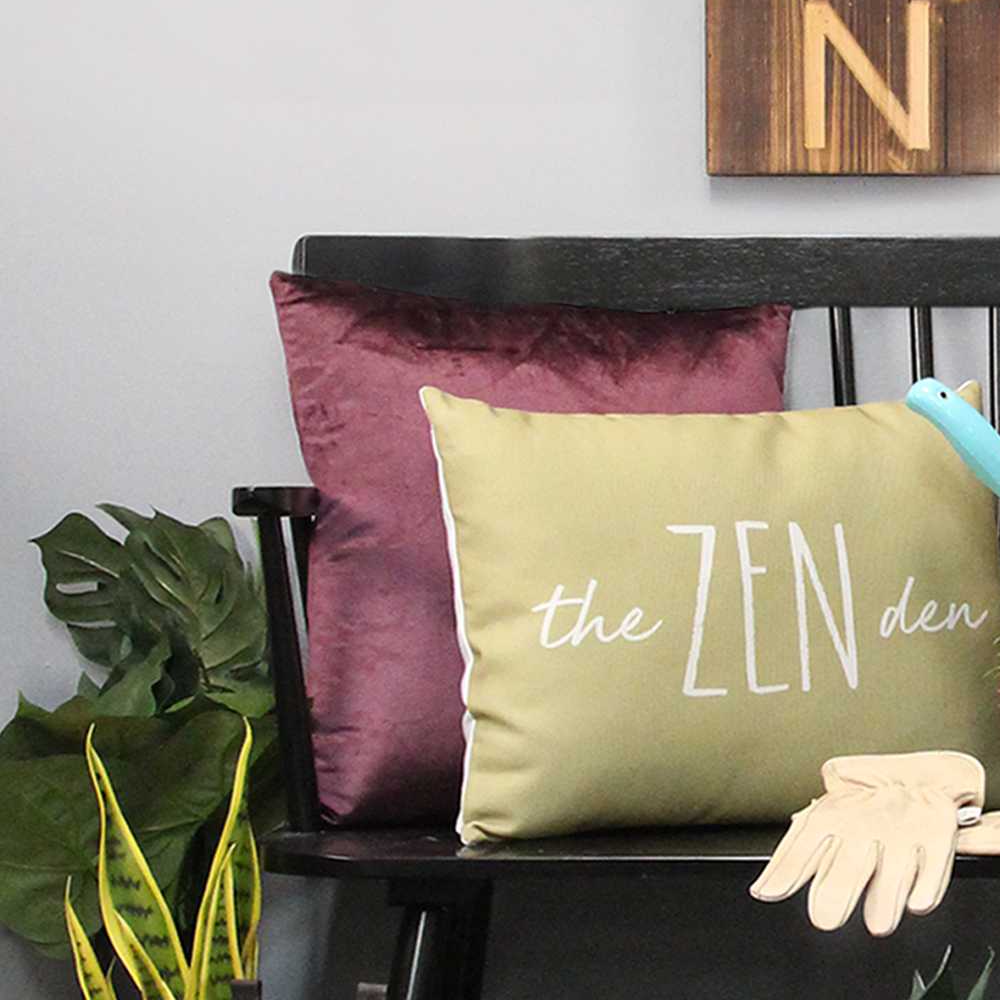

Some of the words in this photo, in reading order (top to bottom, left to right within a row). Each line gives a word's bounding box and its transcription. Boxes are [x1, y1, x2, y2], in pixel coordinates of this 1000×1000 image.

[531, 578, 663, 649] the
[665, 520, 859, 697] ZEN
[878, 576, 989, 639] den
